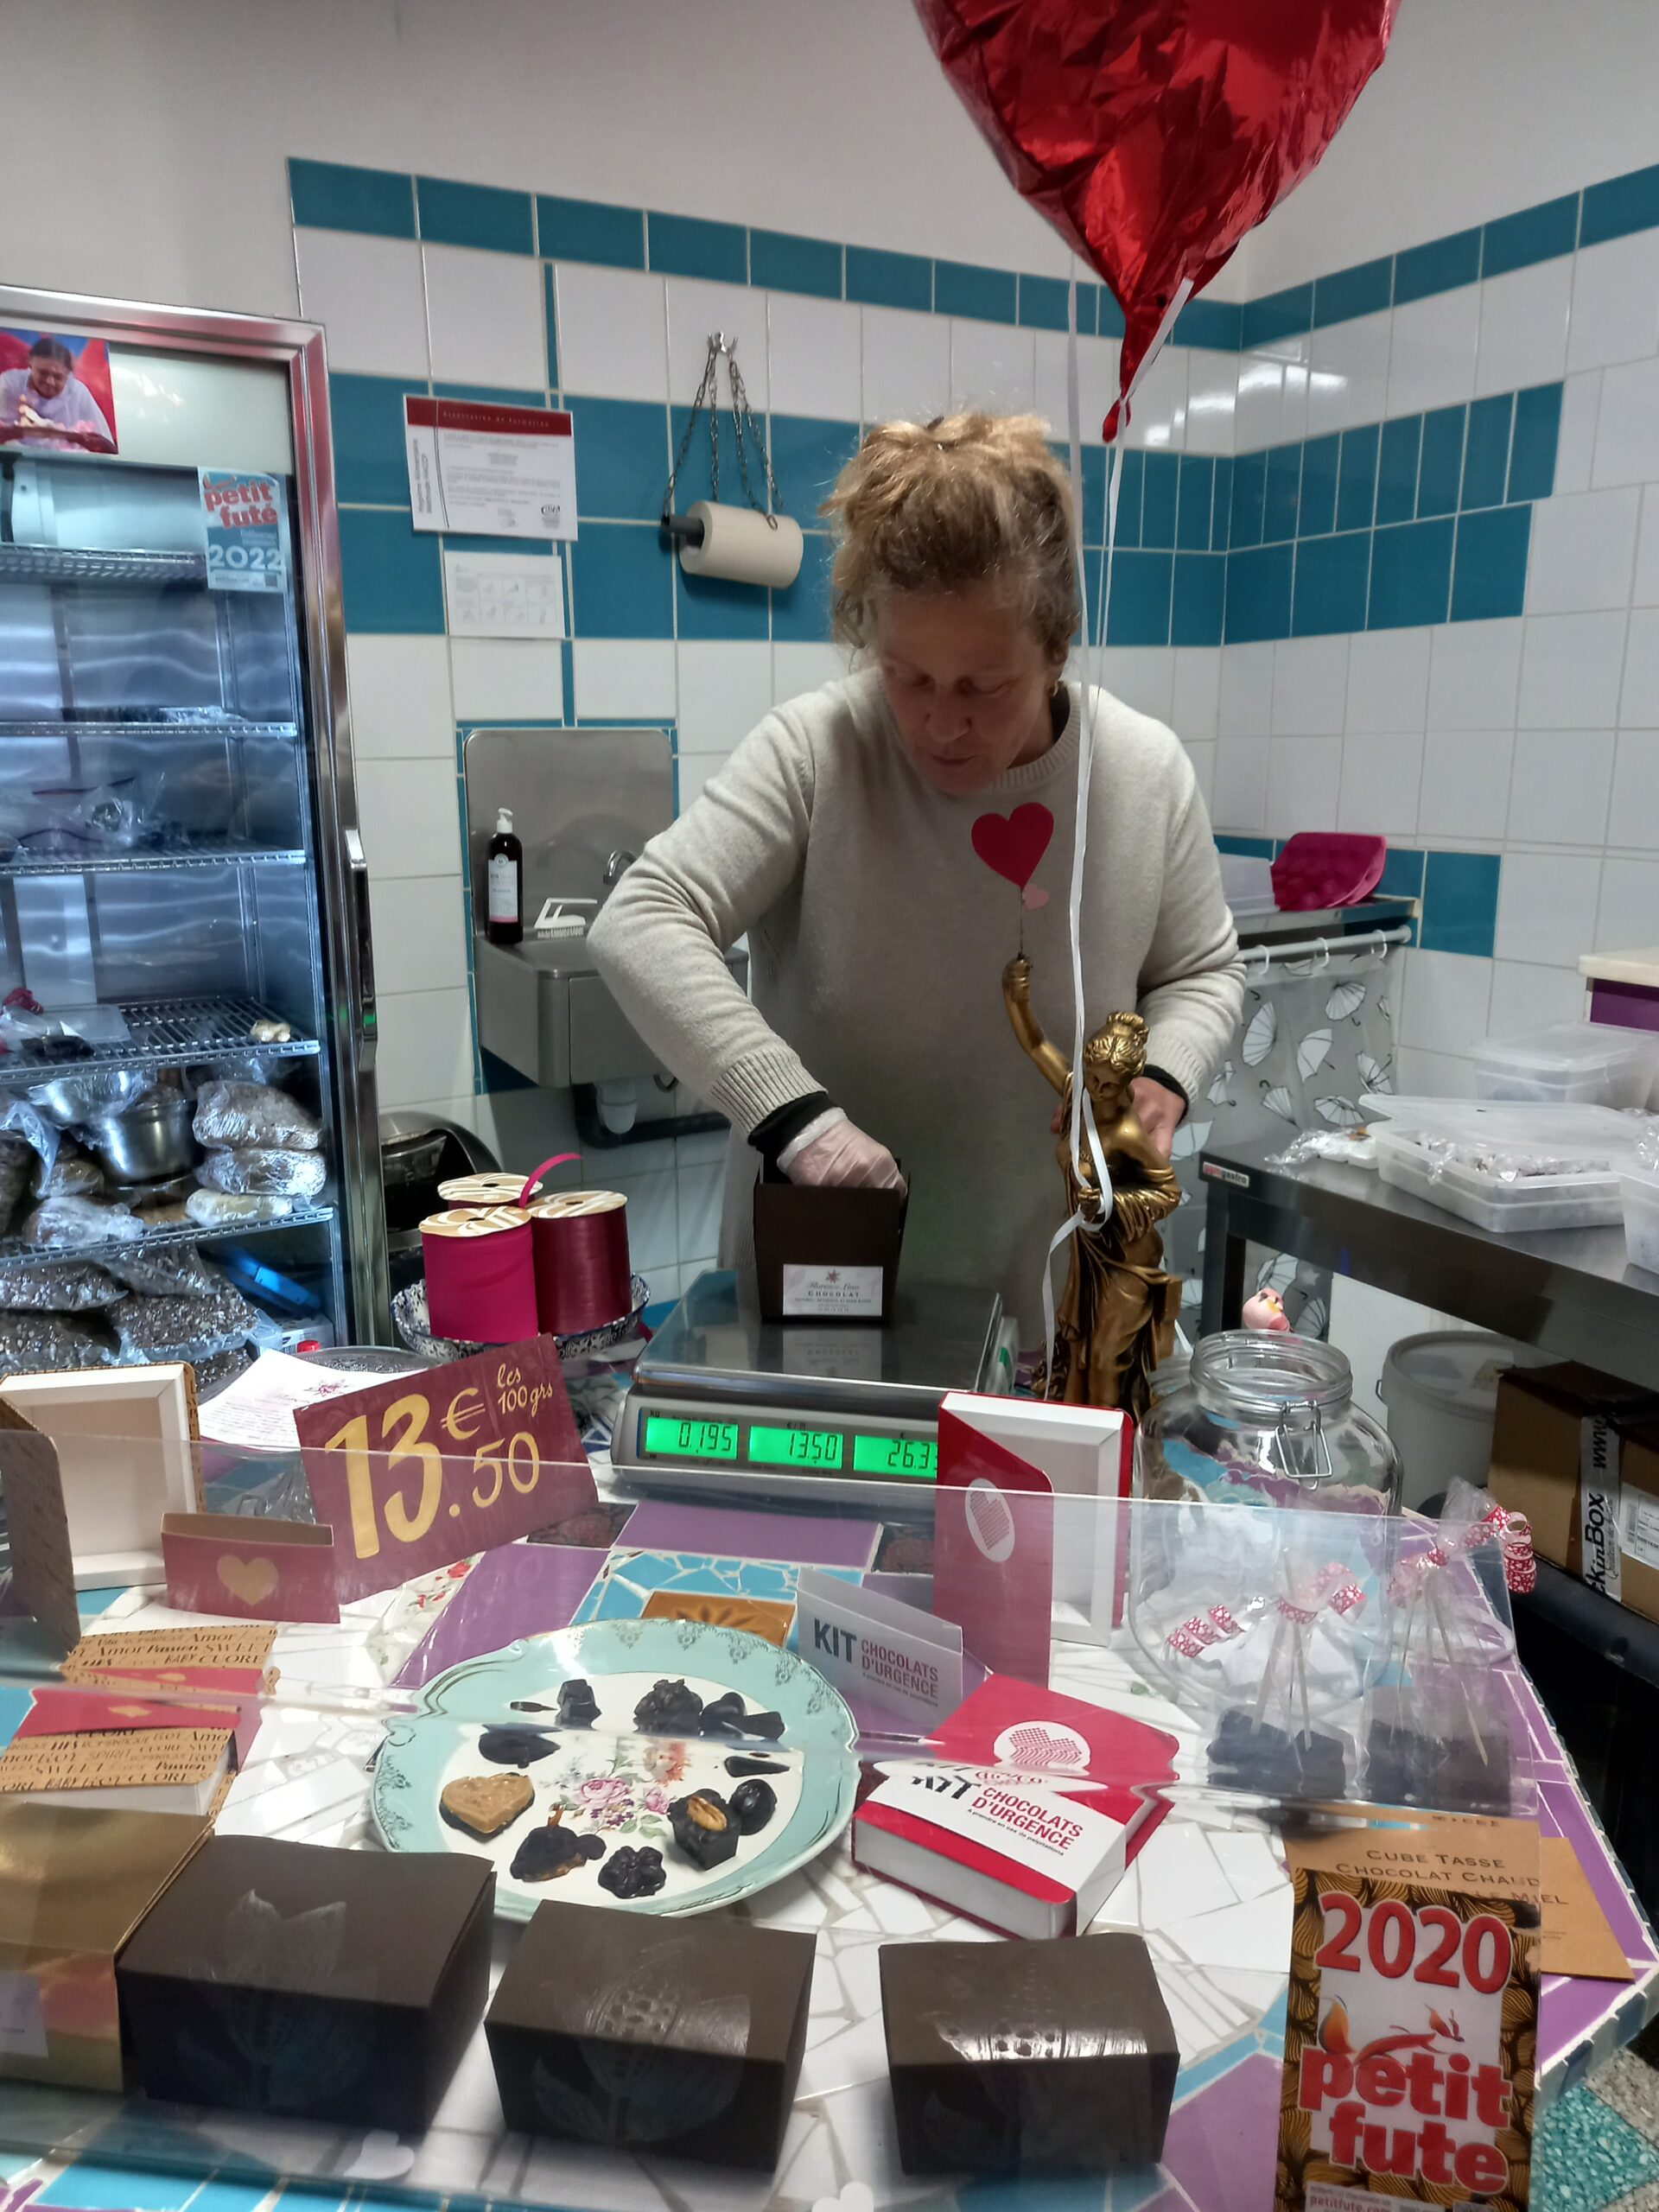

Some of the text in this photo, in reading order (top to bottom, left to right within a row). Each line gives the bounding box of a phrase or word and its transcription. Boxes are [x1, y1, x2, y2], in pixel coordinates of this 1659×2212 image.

[204, 480, 273, 512] petit
[208, 543, 282, 571] 2022
[497, 1363, 521, 1389] les
[887, 1440, 938, 1471] 26.3
[98, 1645, 143, 1656] Amor
[191, 1632, 237, 1643] Amor
[814, 1617, 857, 1664] KIT
[198, 1654, 264, 1664] CUORE
[861, 1639, 938, 1682] CHOCOLATS
[861, 1654, 938, 1700] D'URGENCE
[971, 1796, 1075, 1851] D'URGENCE
[982, 1787, 1084, 1837] CHOCOLATS
[1336, 1863, 1452, 1881] CHOCOLAT
[1366, 1849, 1506, 1869] CUBE TASSE
[1510, 1891, 1570, 1905] MIEL
[1314, 1891, 1512, 1995] 2020
[1298, 2045, 1512, 2129] petit
